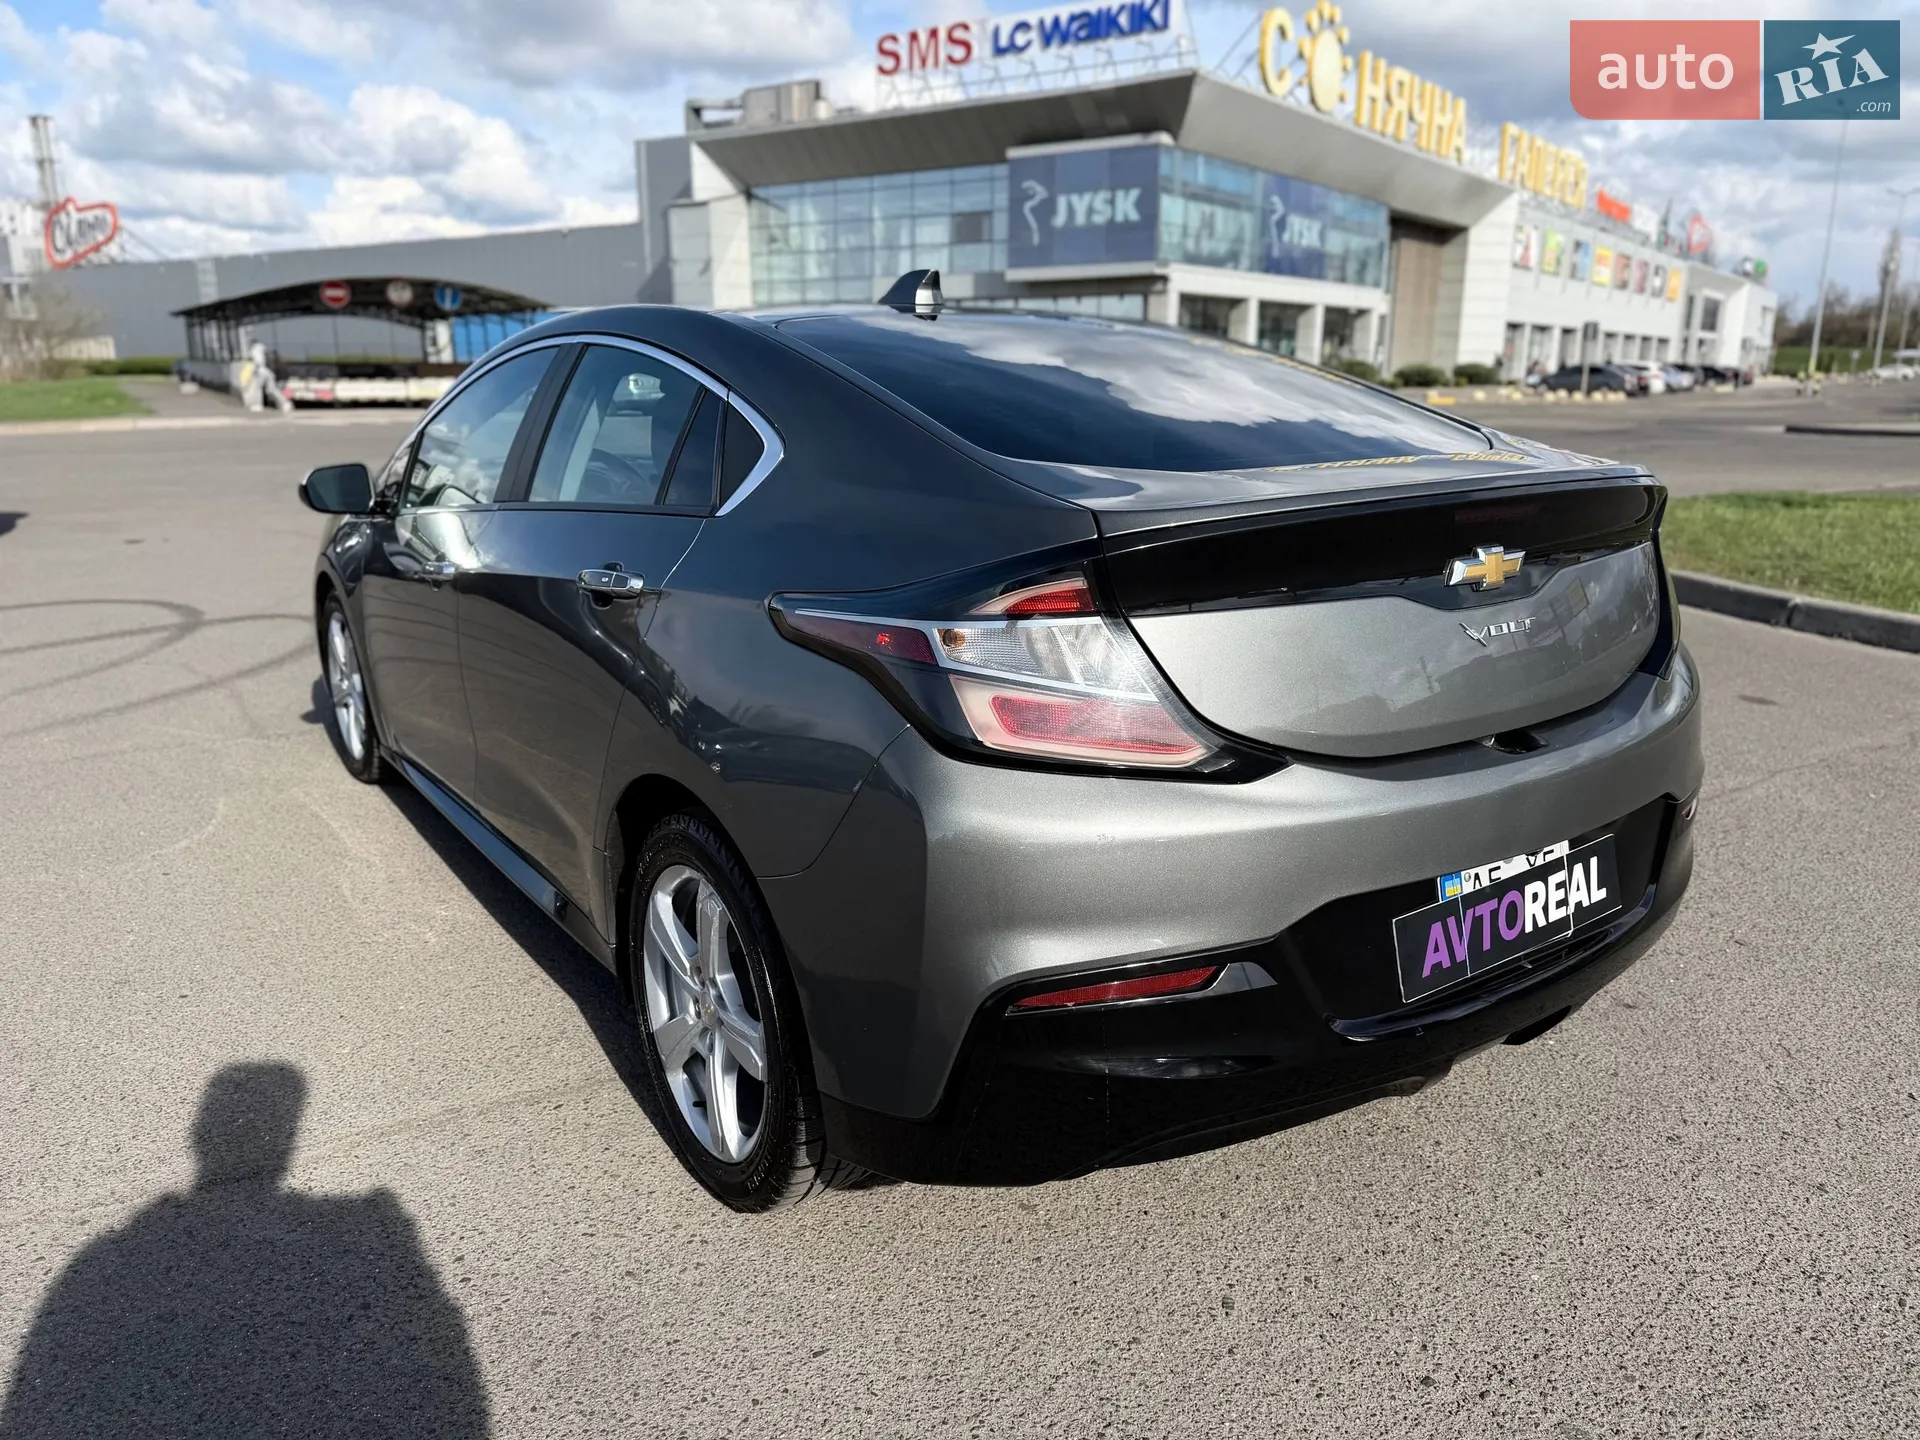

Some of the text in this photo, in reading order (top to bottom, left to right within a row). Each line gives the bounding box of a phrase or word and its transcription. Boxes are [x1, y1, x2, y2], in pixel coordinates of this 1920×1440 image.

[876, 22, 973, 76] SMS
[992, 21, 1033, 57] LC
[1051, 187, 1142, 228] JYSK
[1421, 856, 1607, 979] AVTOREAL
